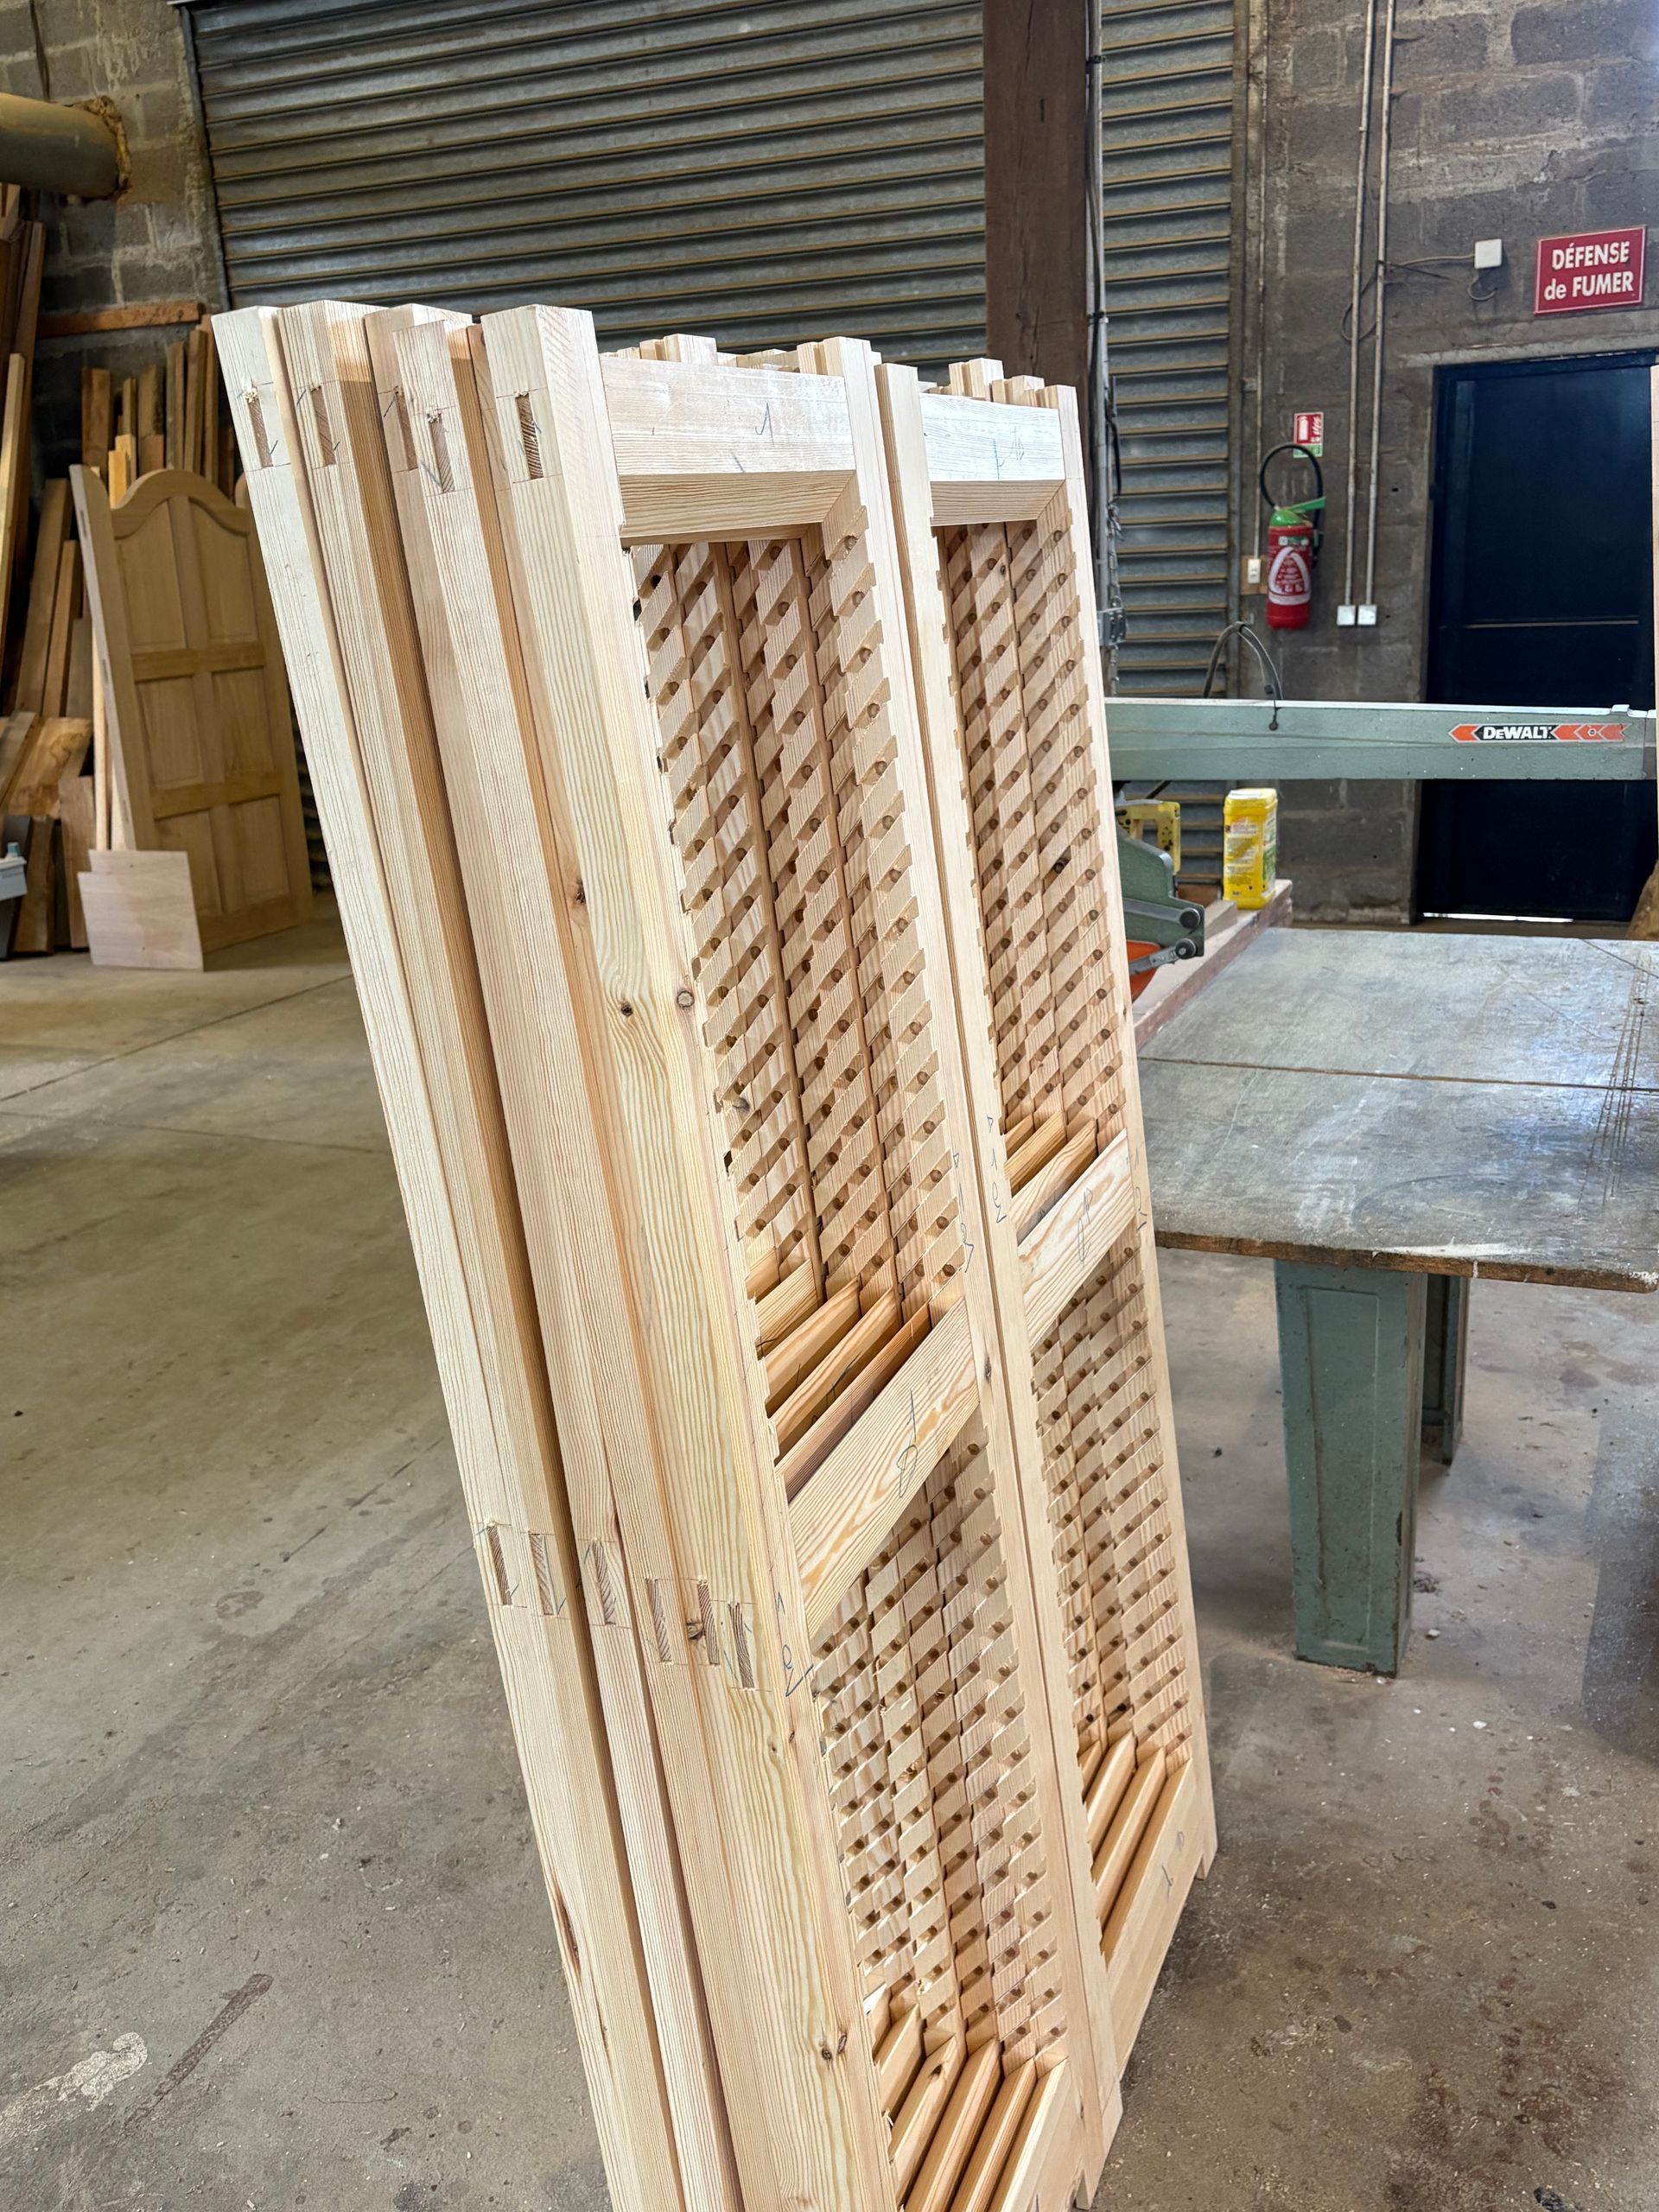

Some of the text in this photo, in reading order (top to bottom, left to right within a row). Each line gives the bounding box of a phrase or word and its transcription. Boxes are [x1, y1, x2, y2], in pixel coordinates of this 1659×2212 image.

[1552, 241, 1630, 270] DÉFENSE
[1544, 271, 1634, 300] de FUMER
